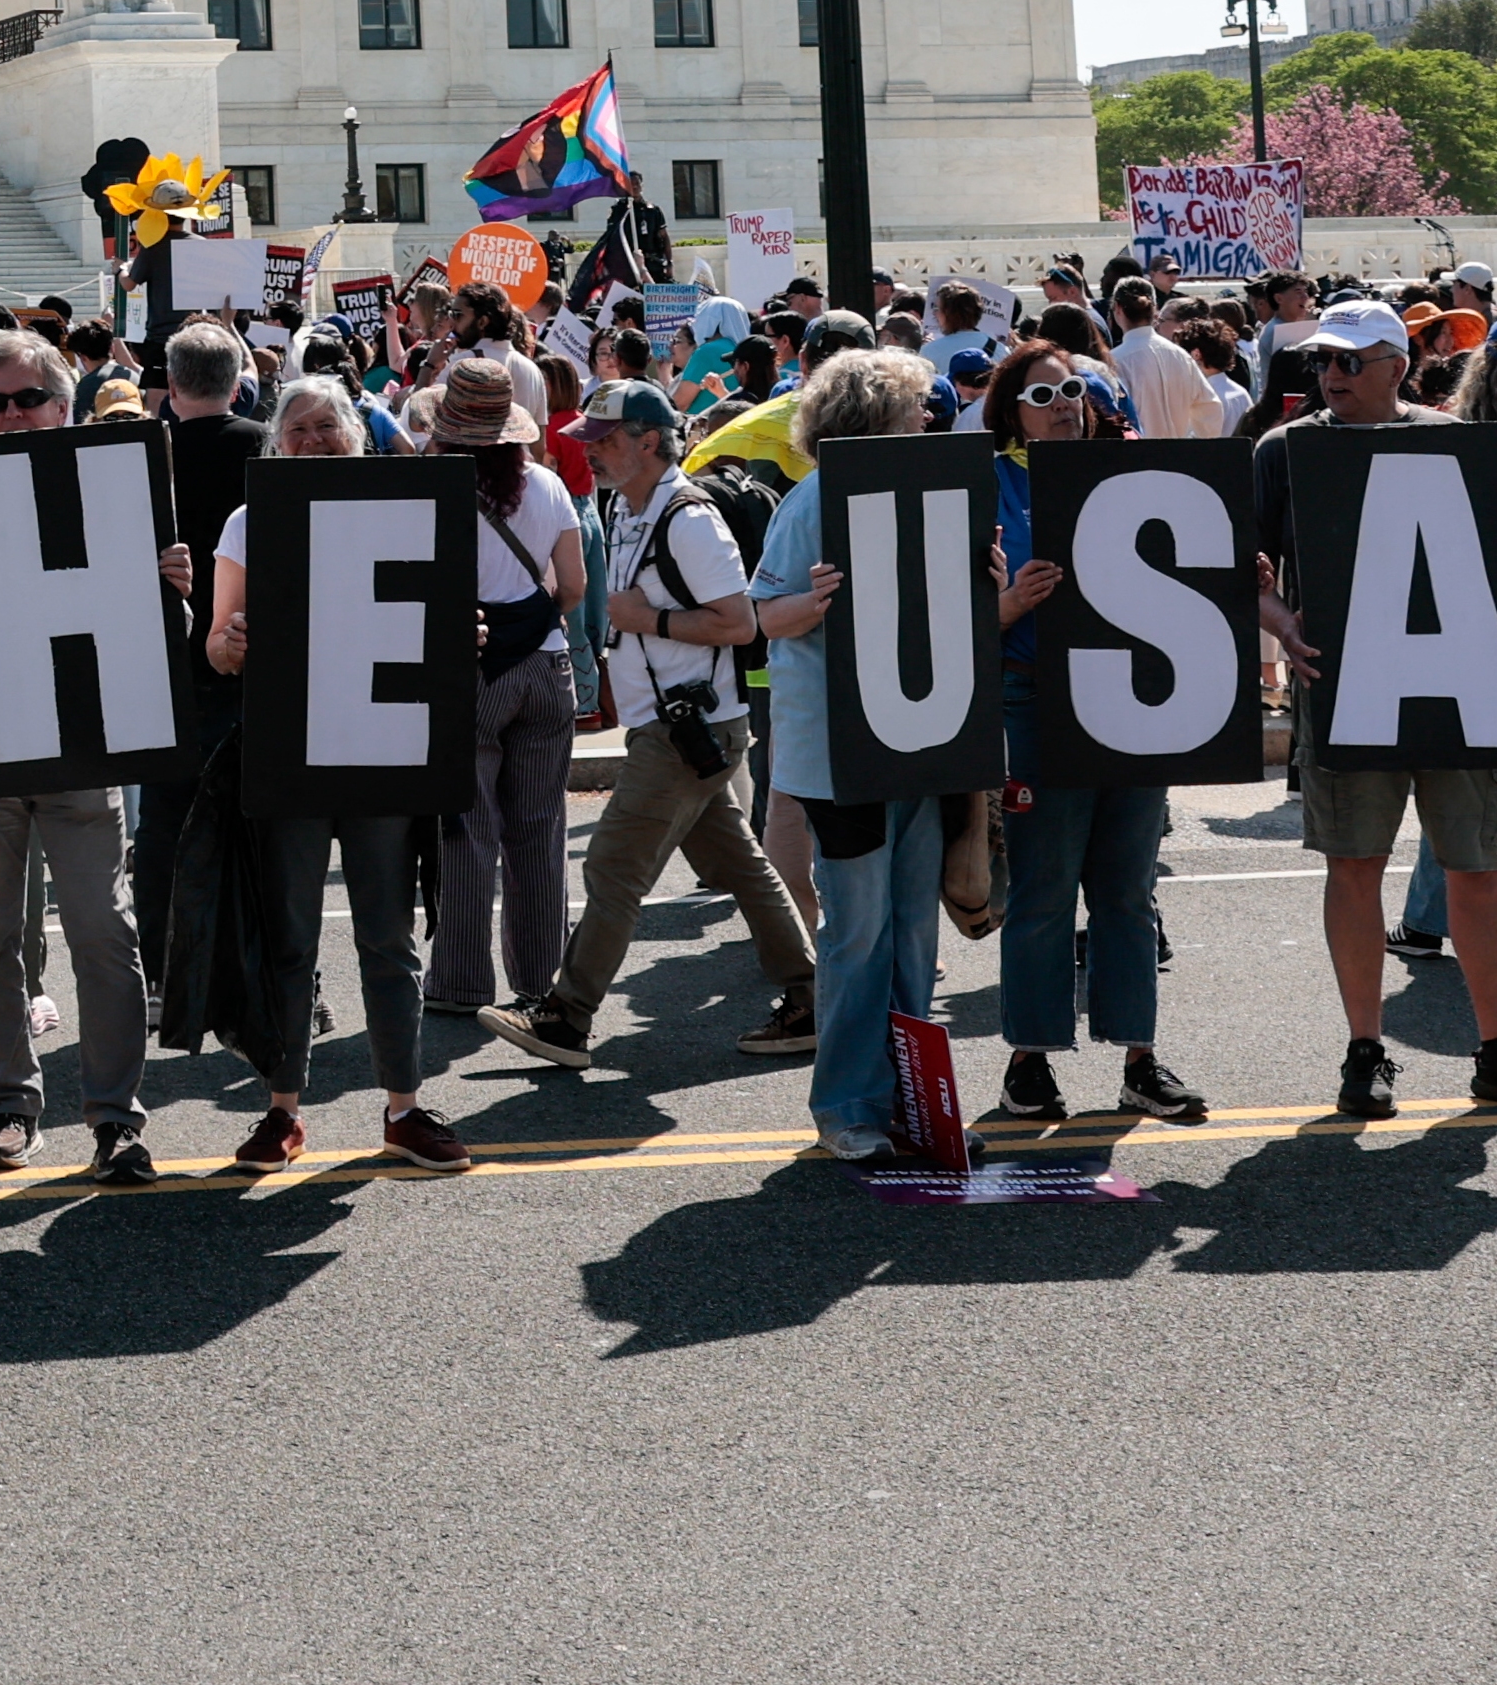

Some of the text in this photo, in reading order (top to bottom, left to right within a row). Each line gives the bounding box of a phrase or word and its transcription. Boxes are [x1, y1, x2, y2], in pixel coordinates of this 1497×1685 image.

[1248, 193, 1276, 227] STOP
[196, 216, 231, 233] TRUMP
[726, 213, 764, 234] TRUMP
[1251, 210, 1293, 252] RACISM
[468, 232, 534, 257] RESPECT
[752, 231, 792, 245] RAPED
[763, 242, 790, 256] KIDS
[1264, 236, 1297, 269] NOW
[265, 258, 302, 274] RUMP
[461, 247, 538, 273] WOMEN OF
[264, 273, 296, 289] UST
[471, 265, 522, 287] COLOR
[263, 288, 285, 302] GO
[646, 285, 698, 294] BIRTHRIGHT
[646, 295, 698, 303] CITIZENSHIP
[345, 307, 381, 323] MUS
[646, 304, 696, 312] BIRTHRIGHT
[553, 330, 562, 341] the
[559, 324, 569, 337] It's
[892, 1022, 923, 1147] AMENDMENT
[907, 1030, 935, 1149] speaks for itself
[938, 1077, 953, 1118] ACLU
[994, 1176, 1114, 1185] BIRTHRIGHT
